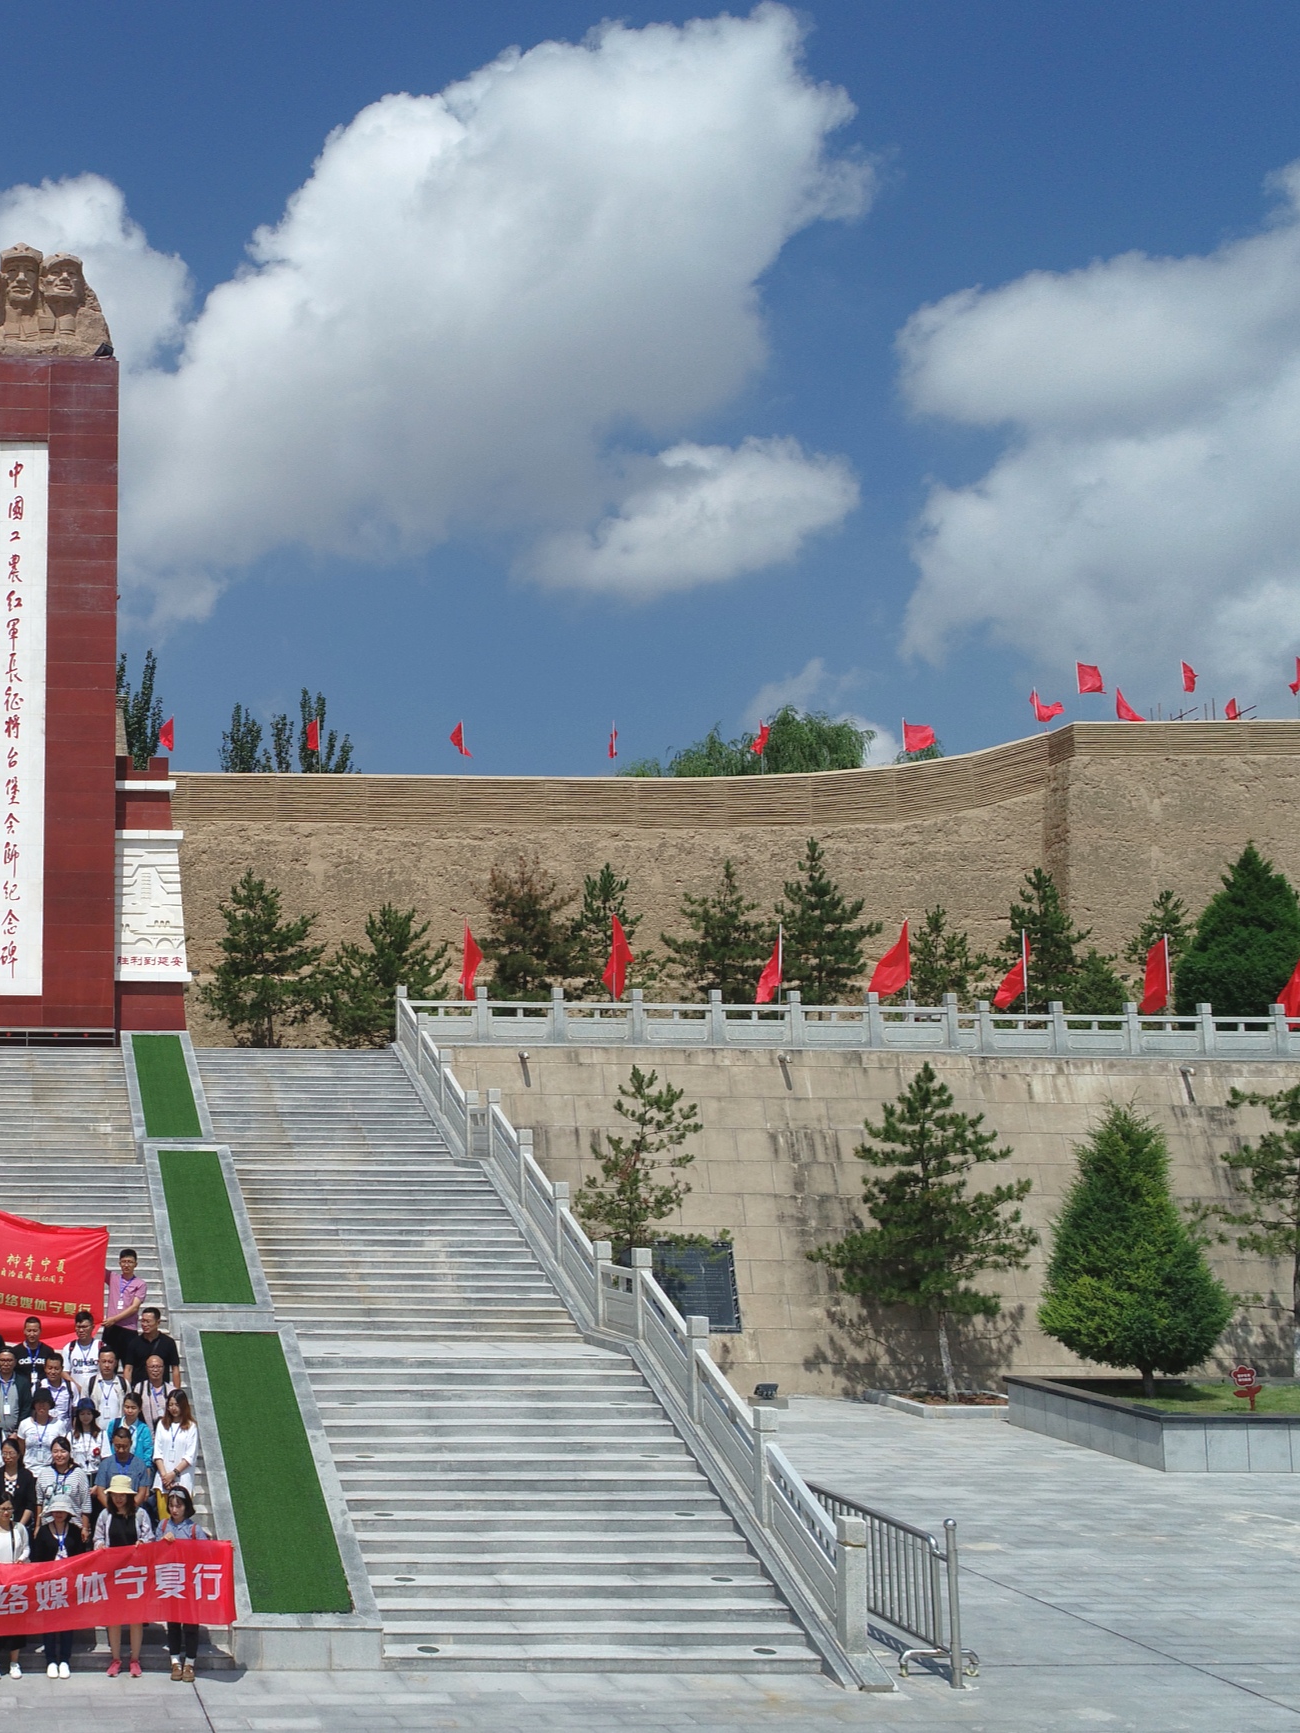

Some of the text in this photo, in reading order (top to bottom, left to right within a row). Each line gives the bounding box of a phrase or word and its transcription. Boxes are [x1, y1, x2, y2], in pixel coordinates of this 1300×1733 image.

[116, 955, 185, 967] 胜利到延安
[6, 1253, 66, 1275] 神奇宁夏
